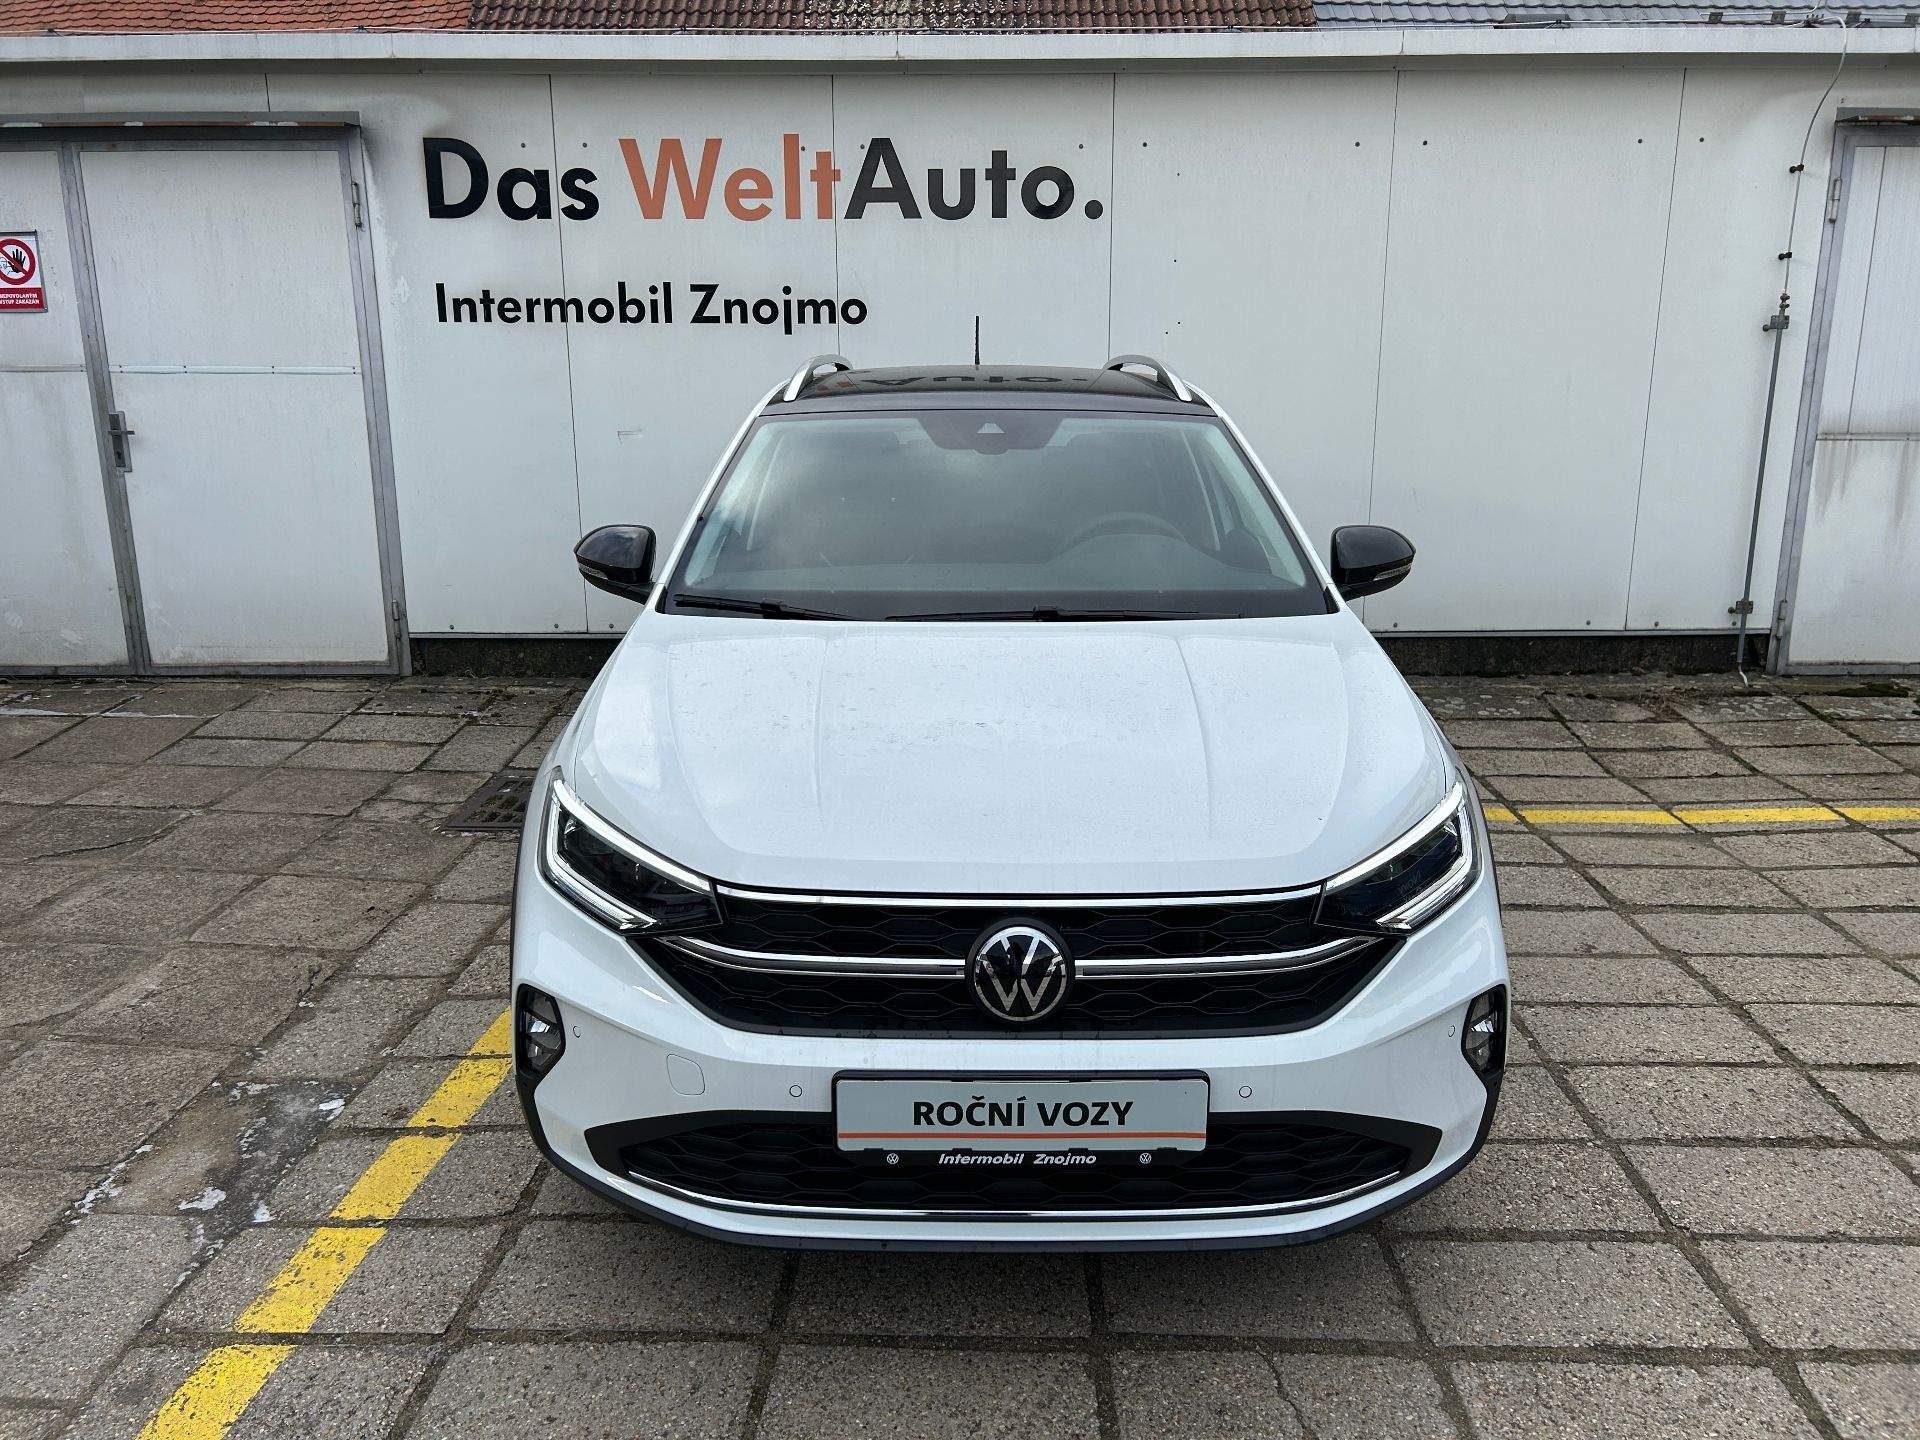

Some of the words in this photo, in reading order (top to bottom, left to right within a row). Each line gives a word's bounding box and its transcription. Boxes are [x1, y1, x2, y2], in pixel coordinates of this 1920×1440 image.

[422, 136, 600, 221] Das
[618, 133, 1105, 222] WeltAuto.
[435, 281, 673, 325] Intermobil
[689, 283, 868, 335] Znojmo
[913, 1095, 1027, 1127] ROČNÍ
[1037, 1101, 1134, 1127] VOZY
[938, 1153, 1025, 1165] Intermobil
[1033, 1153, 1097, 1166] Znojmo
